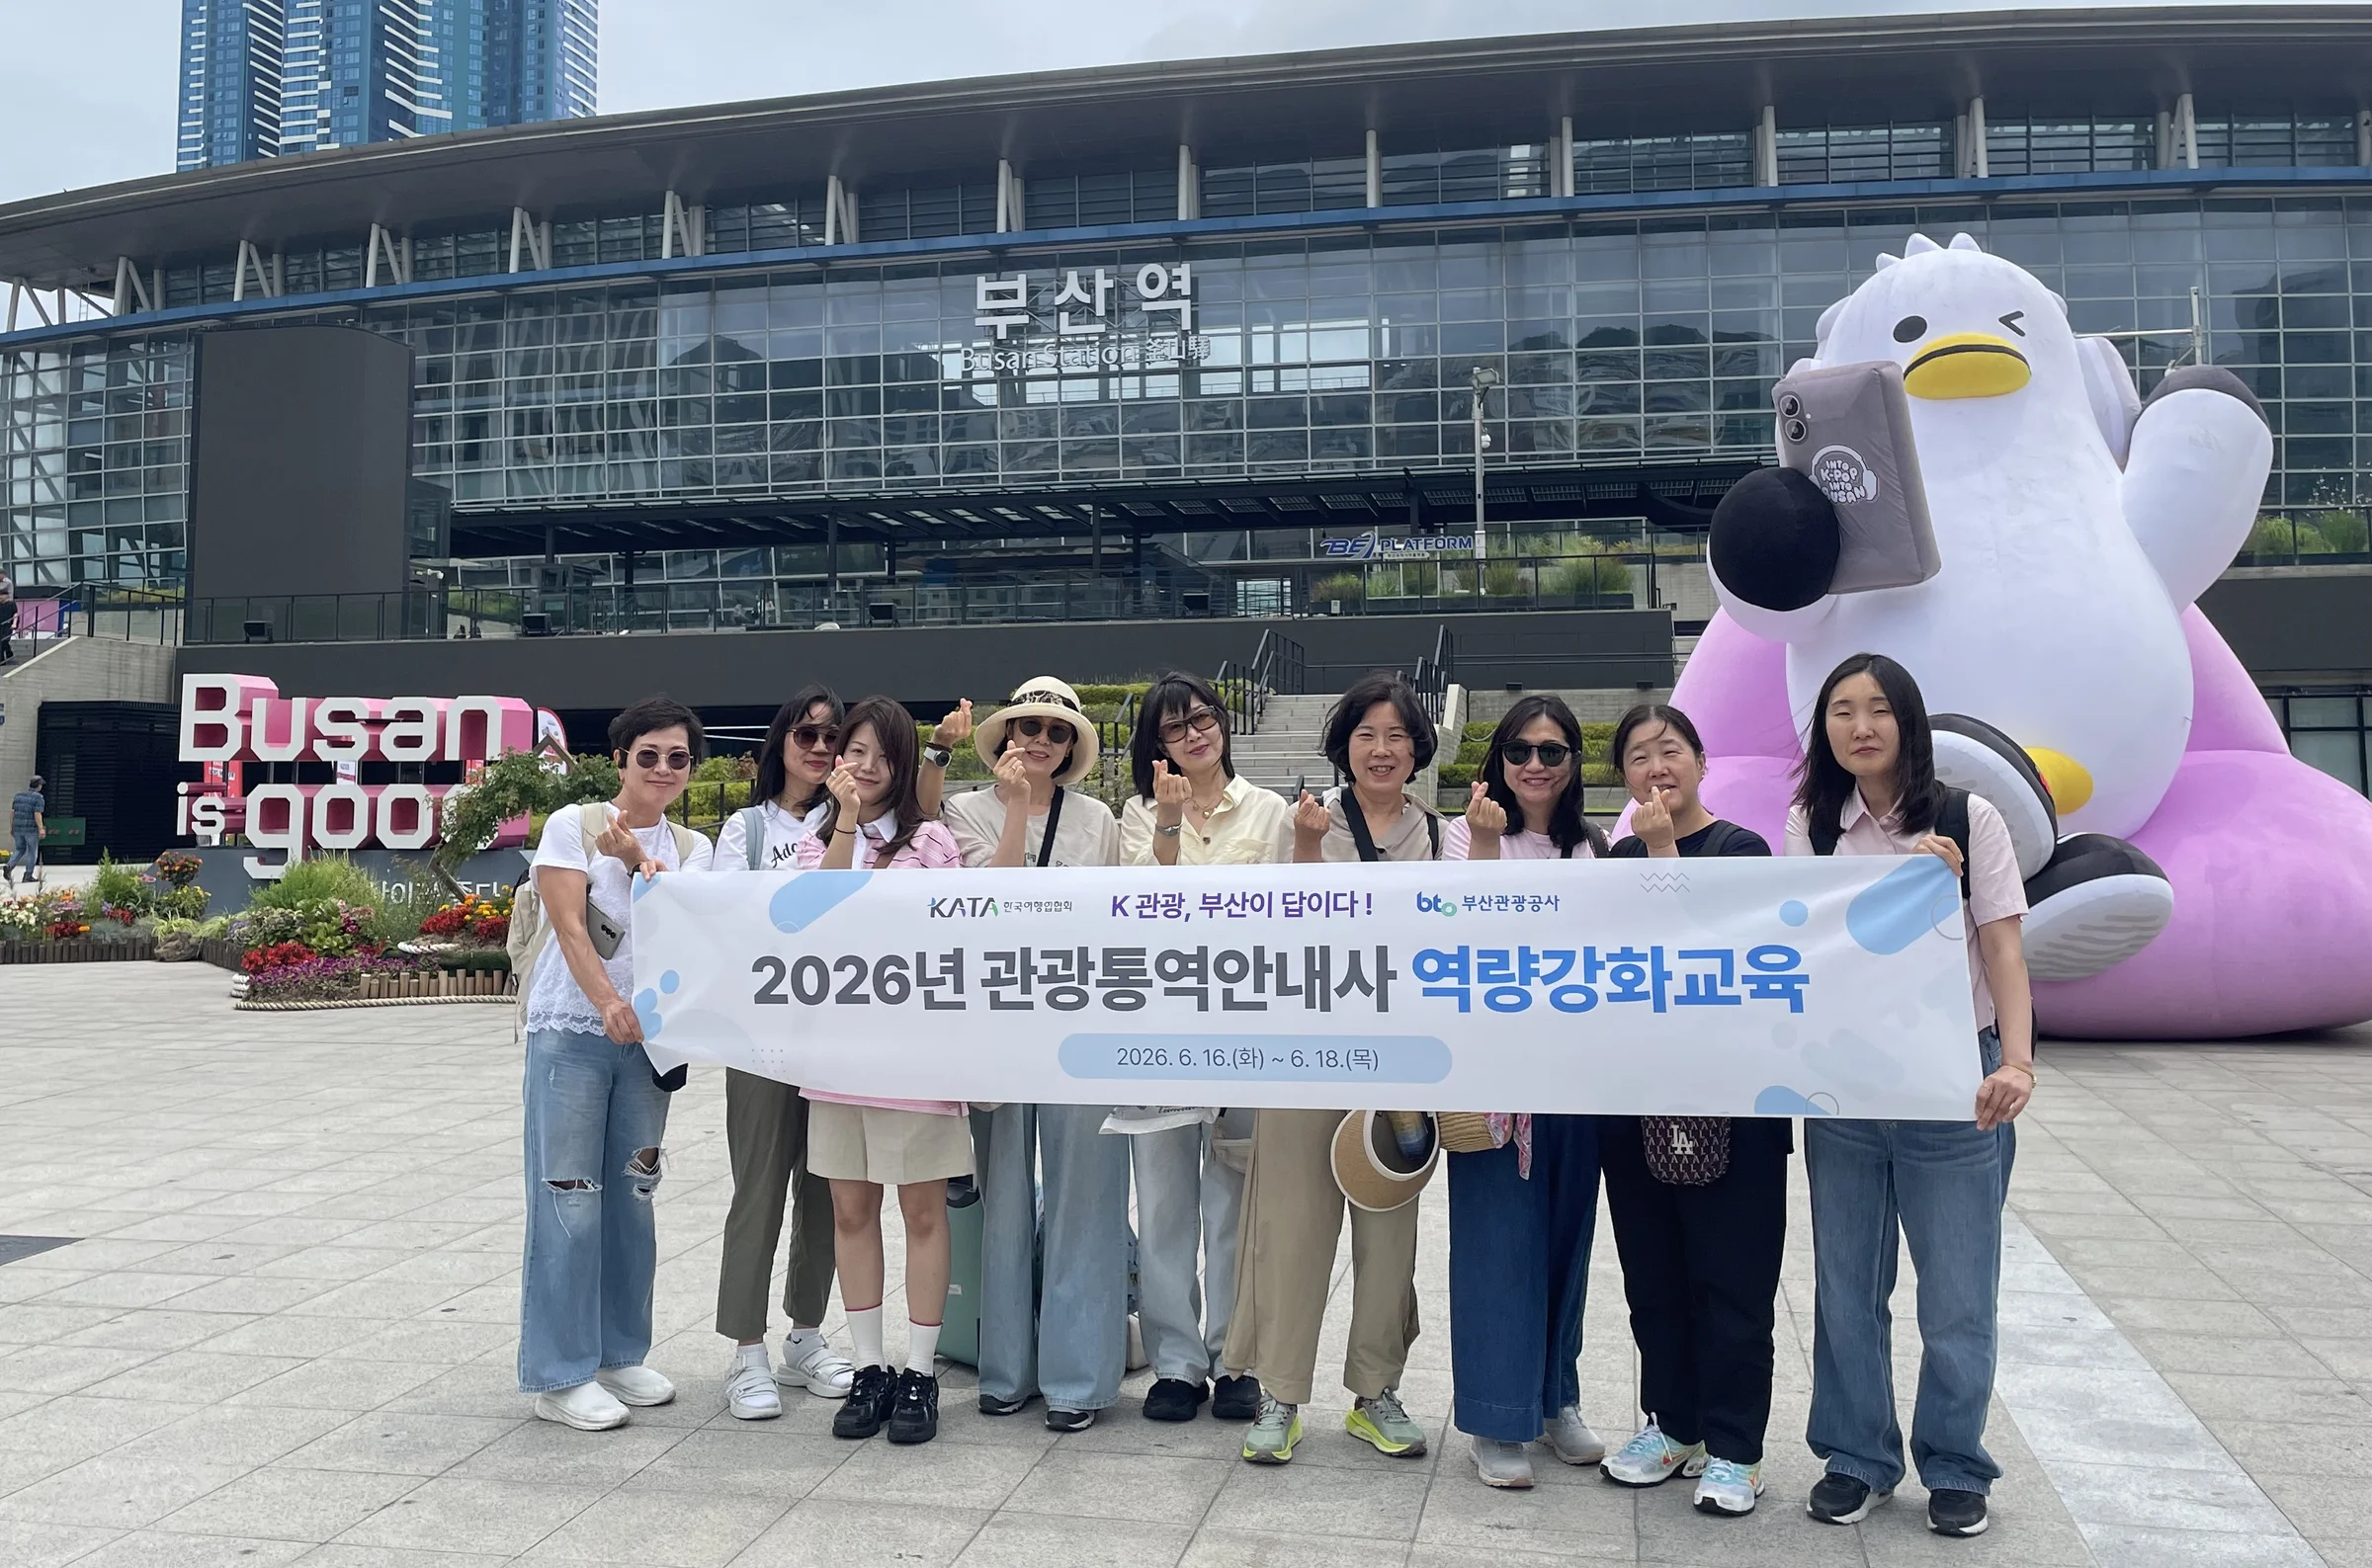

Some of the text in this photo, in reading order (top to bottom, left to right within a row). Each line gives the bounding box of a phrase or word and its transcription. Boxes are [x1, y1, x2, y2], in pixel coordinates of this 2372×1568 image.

[974, 263, 1191, 340] 부산역
[961, 341, 1137, 371] Busan Station
[1821, 467, 1858, 481] K-POP
[1825, 459, 1849, 470] INTO
[1829, 481, 1852, 491] INTO
[1381, 536, 1474, 552] PLATFORM
[179, 674, 503, 762] Busan
[177, 782, 225, 836] is
[927, 897, 999, 918] KATA
[1111, 895, 1131, 917] K
[1136, 892, 1191, 922] 관광,
[1199, 891, 1273, 918] 부산이
[1416, 891, 1458, 917] bto
[1462, 895, 1561, 913] 부산관광공사
[751, 944, 1811, 1014] 2026년 관광통역안내사 역량강화교육
[1117, 1047, 1173, 1067] 2026.
[1179, 1047, 1197, 1067] 6.
[1202, 1046, 1264, 1070] 16.(화)
[1291, 1049, 1310, 1068] 6.
[1315, 1048, 1379, 1072] 18.(목)
[1670, 1124, 1694, 1155] LA
